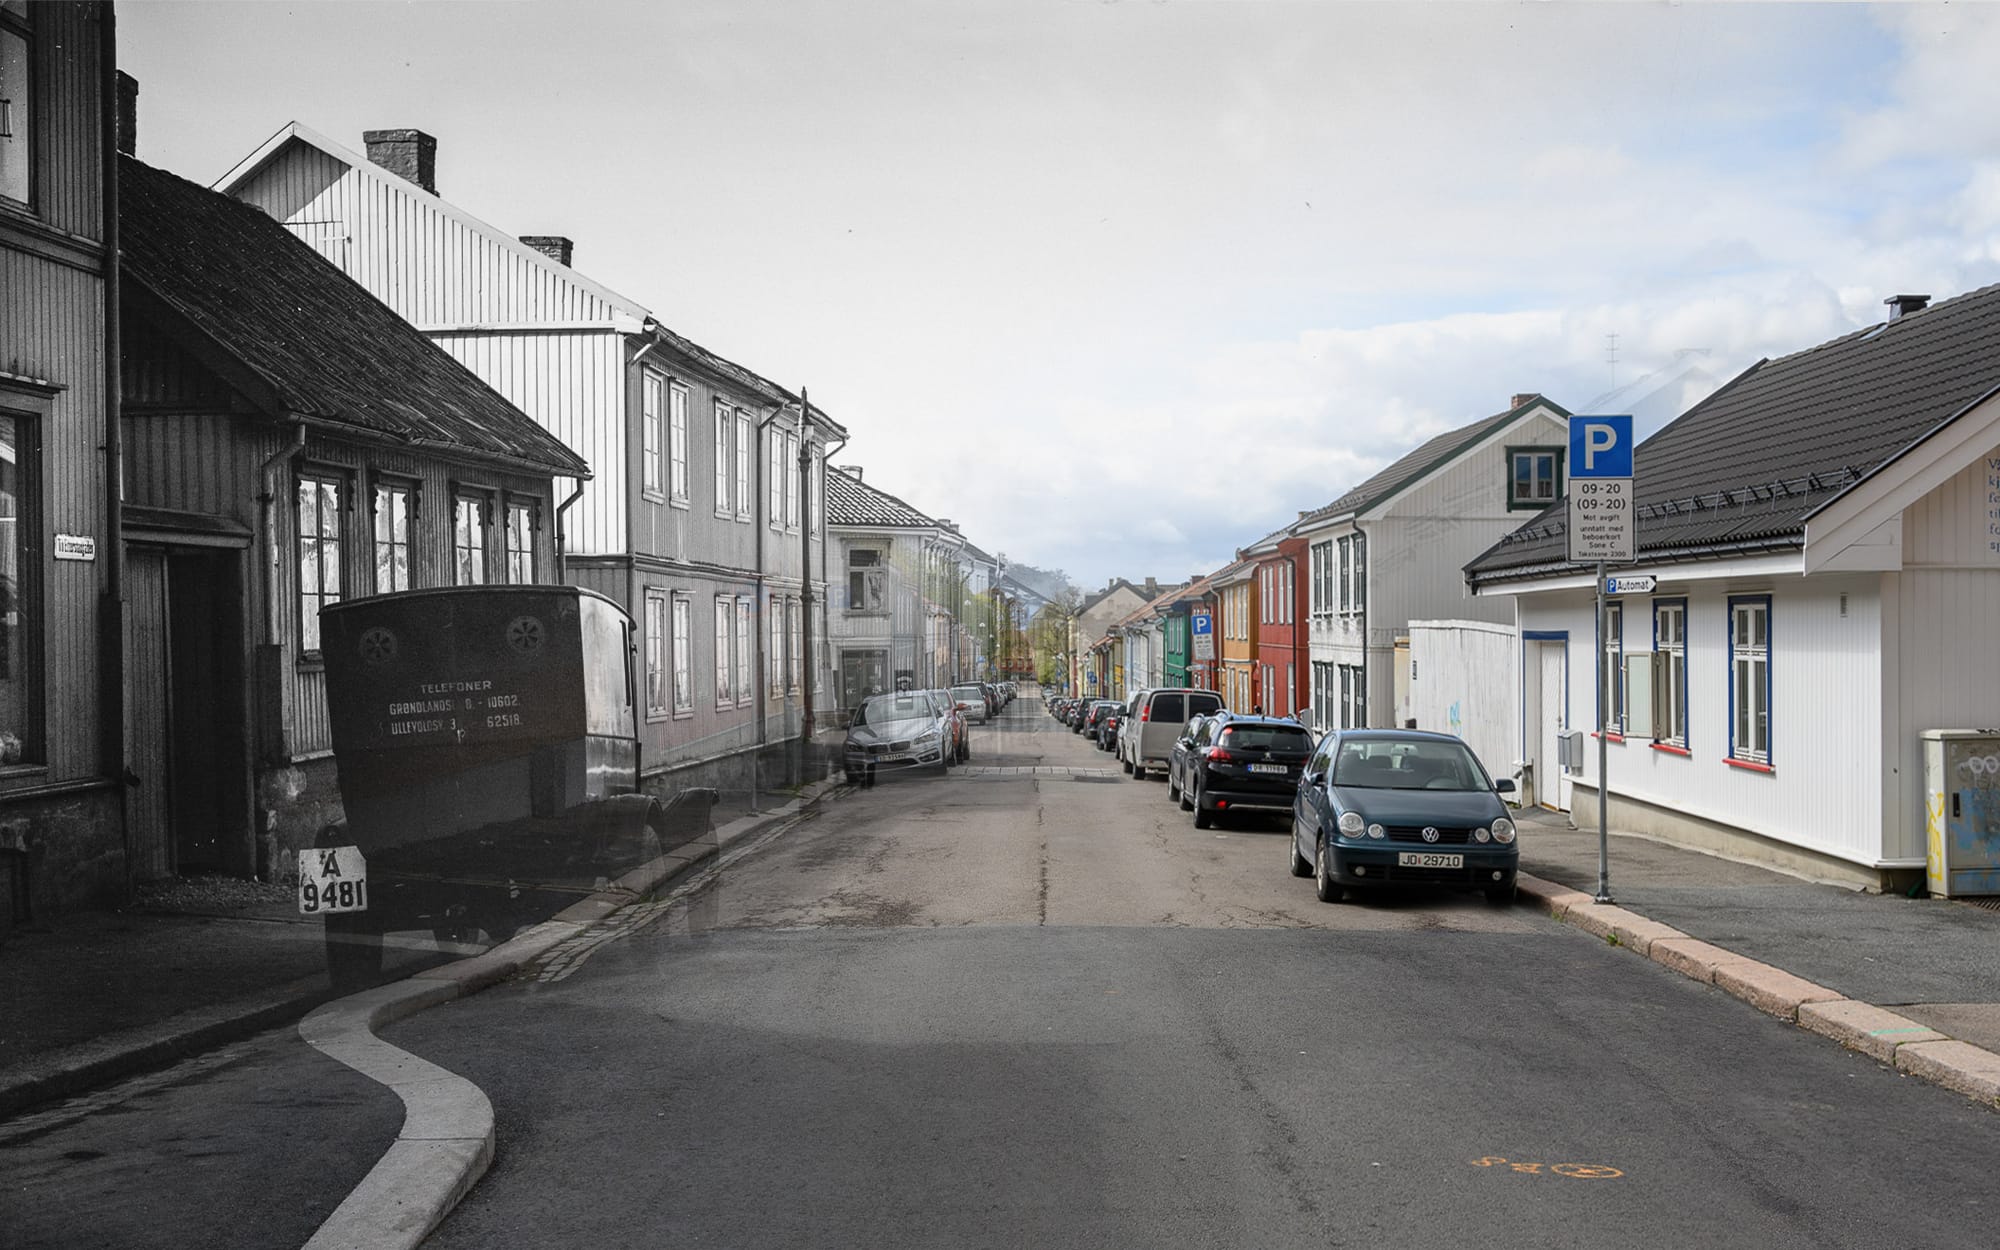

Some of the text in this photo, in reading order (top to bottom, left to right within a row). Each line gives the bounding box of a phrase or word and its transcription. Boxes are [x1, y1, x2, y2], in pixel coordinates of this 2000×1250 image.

[1584, 423, 1618, 470] P
[1582, 483, 1621, 494] 09-20
[1577, 498, 1626, 510] (09-20)
[1599, 514, 1620, 522] avgift
[1588, 541, 1615, 549] Sone C
[1609, 579, 1649, 592] P Automat
[1196, 617, 1207, 633] P
[420, 680, 492, 694] TELEFONER
[321, 850, 342, 878] A
[1423, 855, 1460, 867] 29710
[303, 879, 364, 912] 9481
